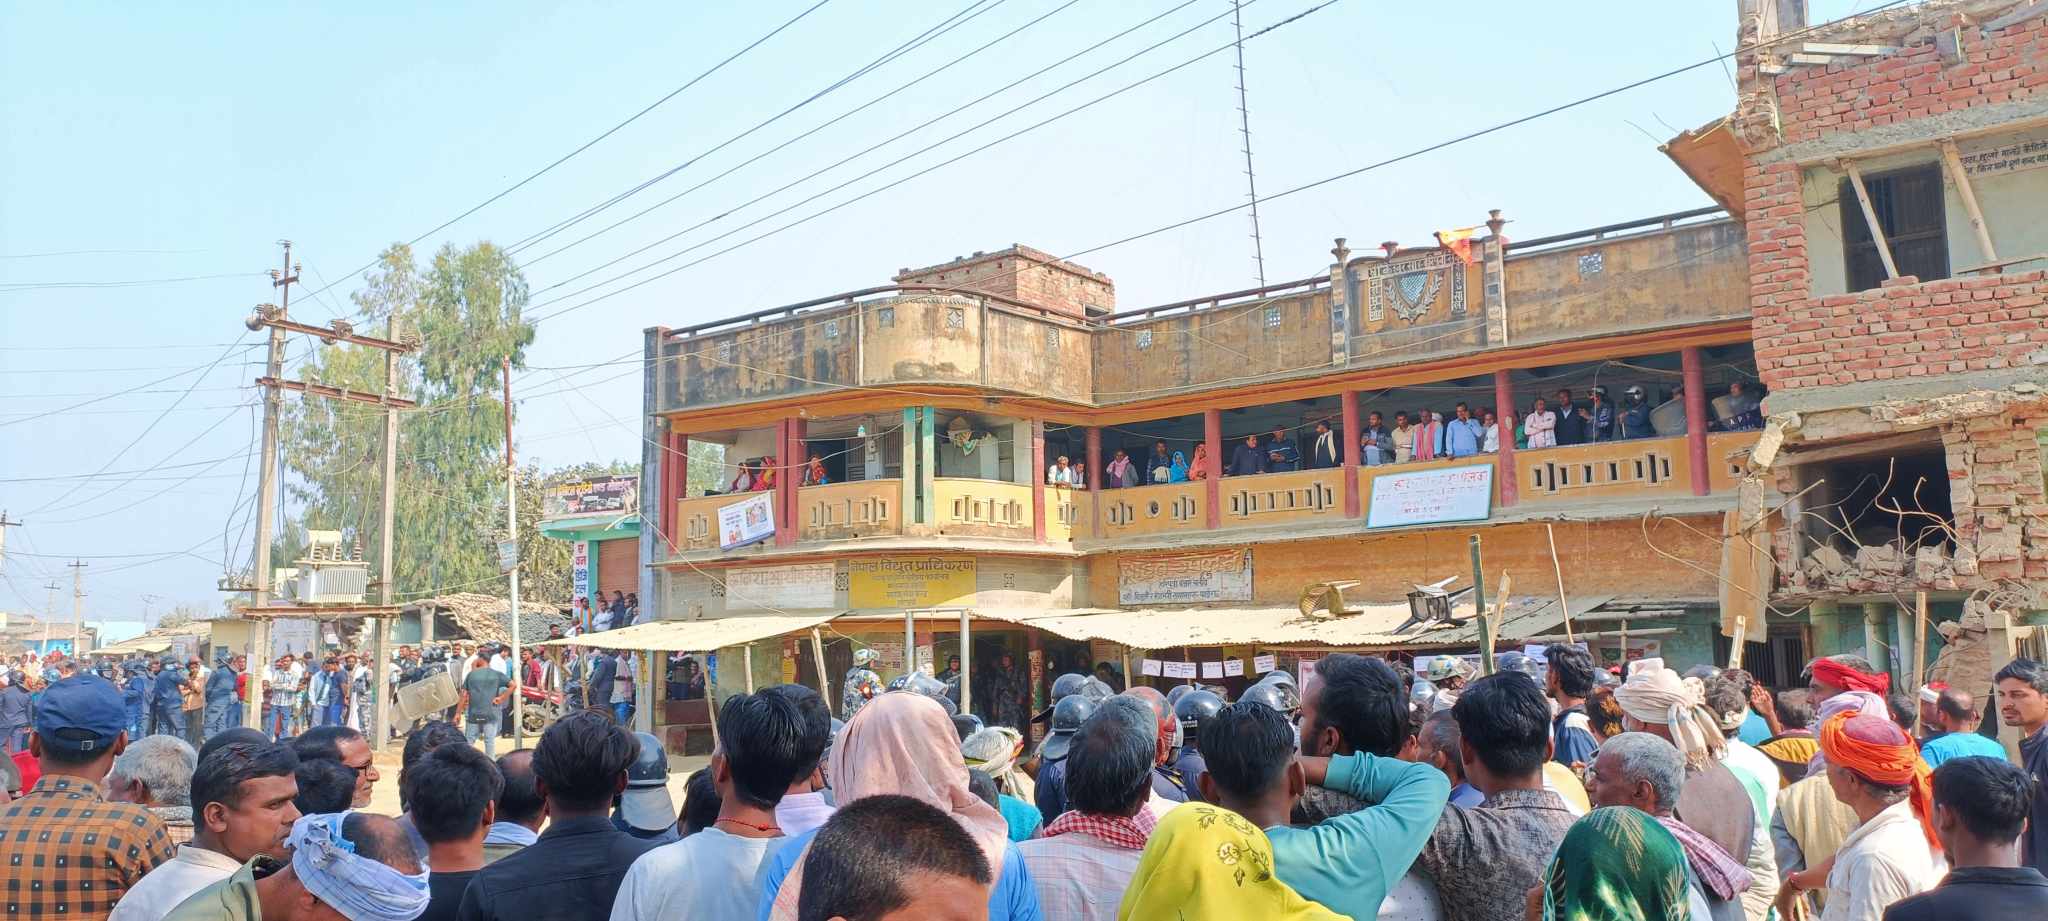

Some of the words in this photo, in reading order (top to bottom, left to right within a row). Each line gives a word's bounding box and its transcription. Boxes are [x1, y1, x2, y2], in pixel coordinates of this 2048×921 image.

[850, 561, 878, 573] नेपाल
[880, 558, 913, 574] विद्युत
[915, 558, 973, 572] प्राधिकरण
